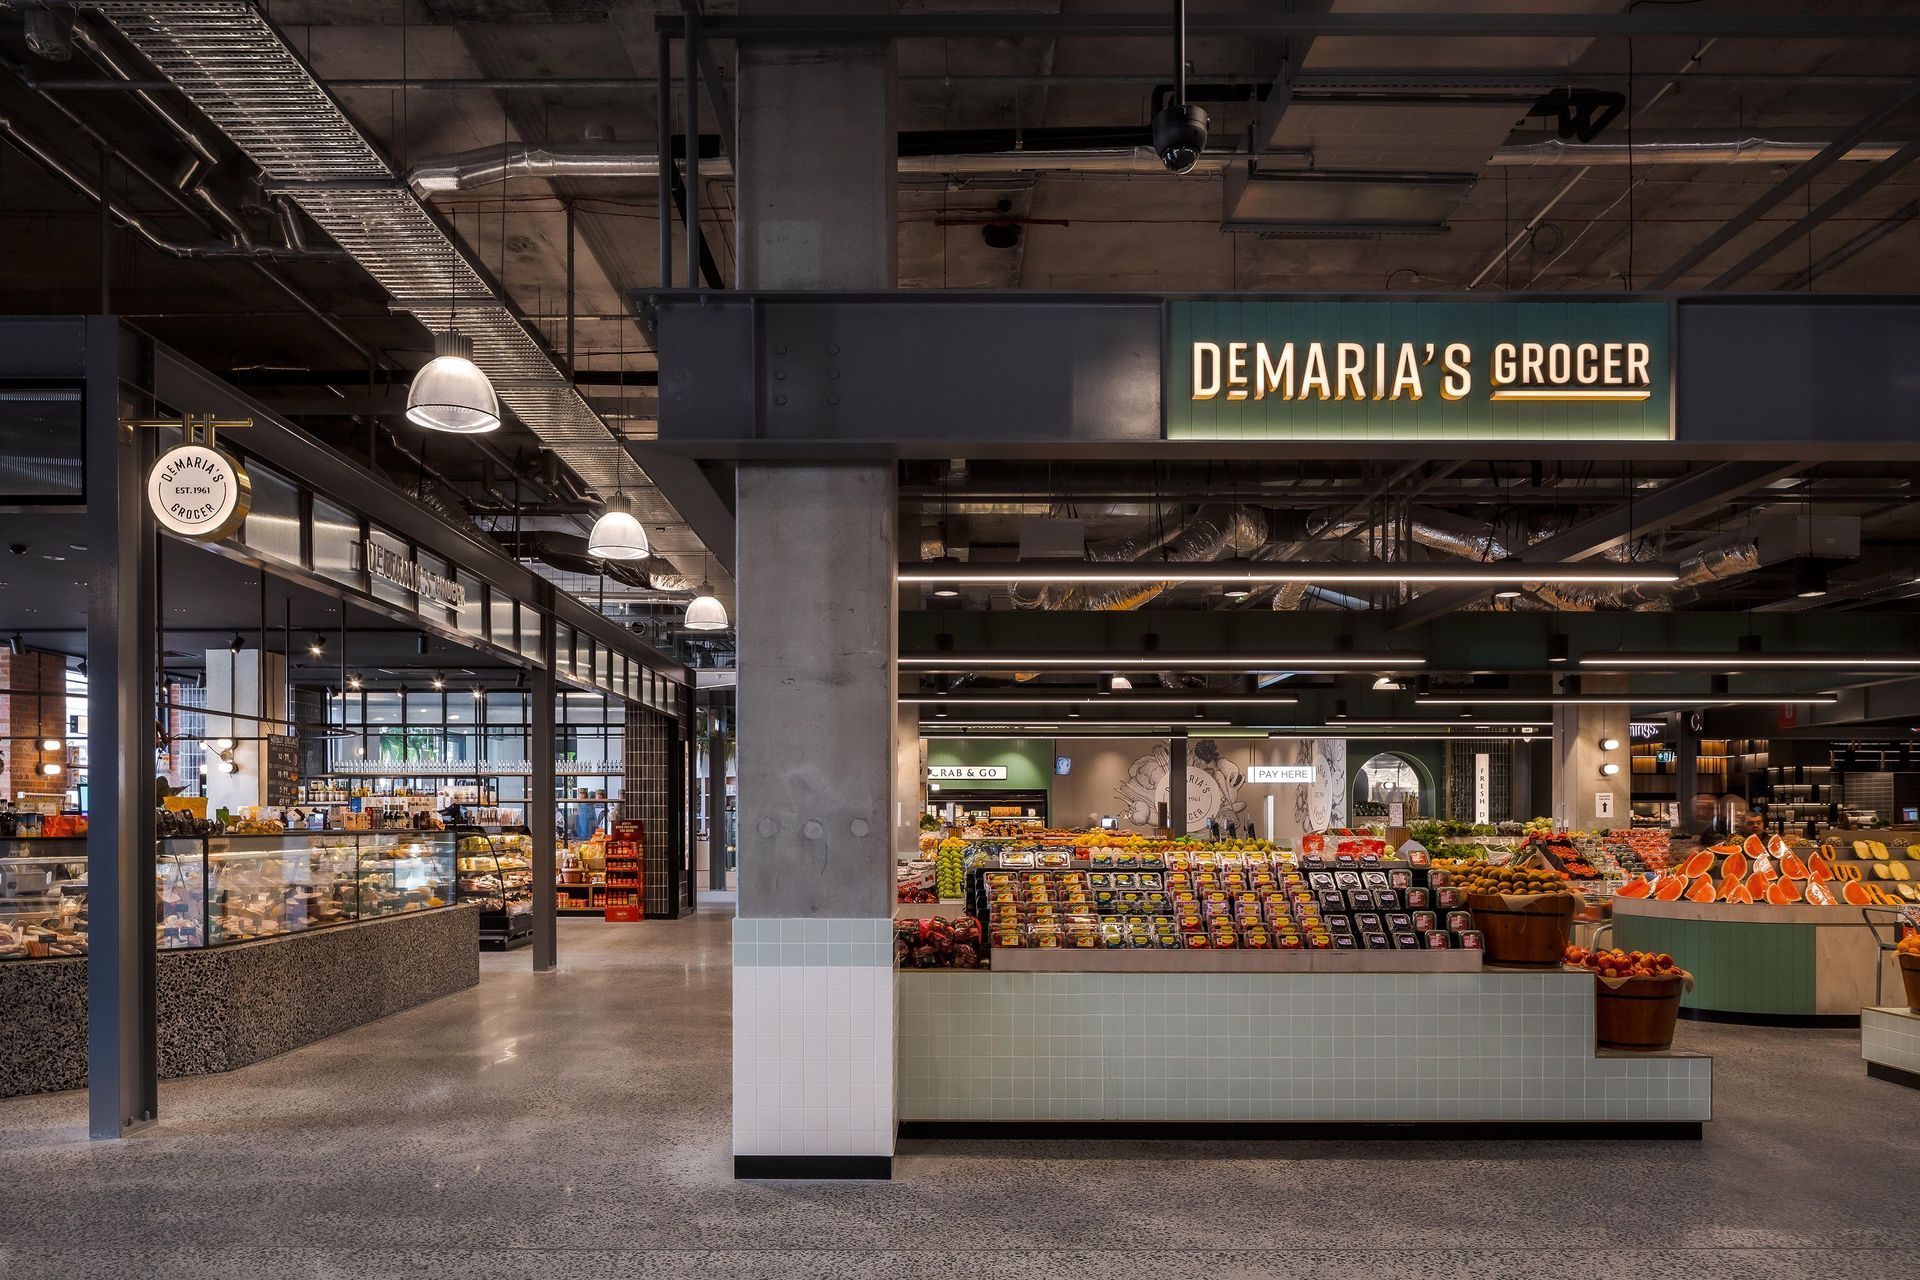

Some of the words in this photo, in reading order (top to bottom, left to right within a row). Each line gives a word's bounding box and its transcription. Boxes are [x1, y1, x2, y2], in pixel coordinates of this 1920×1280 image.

[1491, 342, 1652, 386] GROCER
[170, 503, 215, 520] GROCER
[967, 769, 975, 777] &
[979, 769, 997, 777] GO
[1259, 770, 1278, 779] PAY
[1281, 770, 1308, 779] HERE
